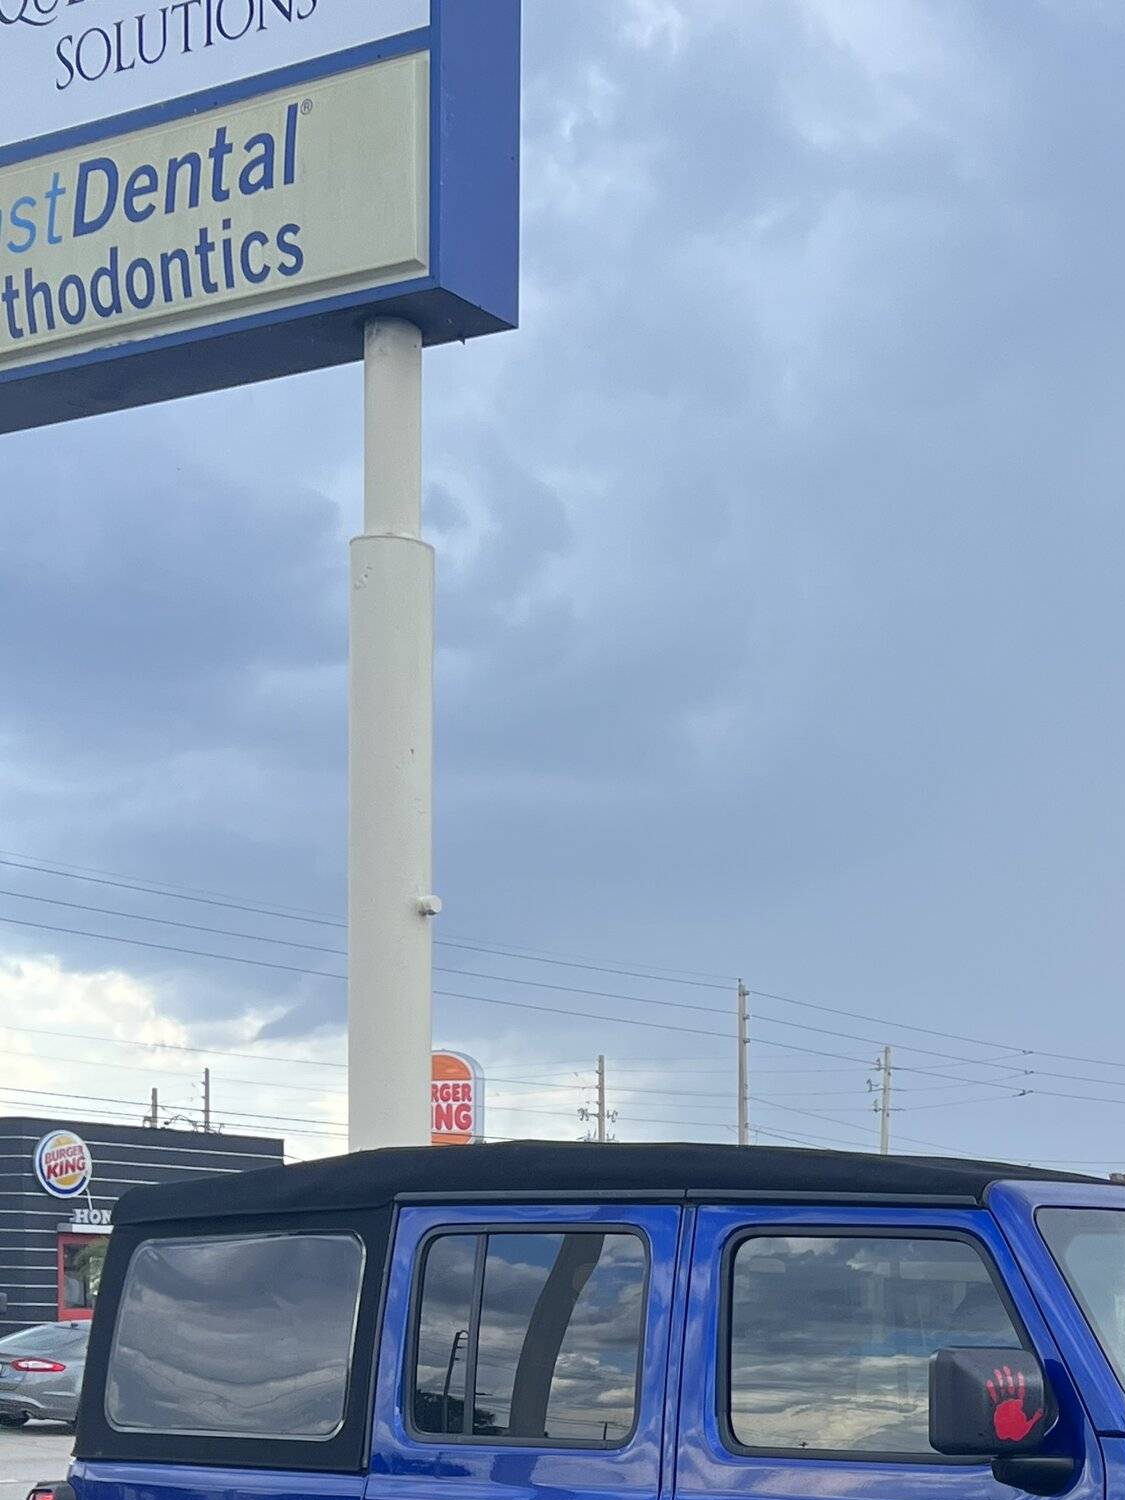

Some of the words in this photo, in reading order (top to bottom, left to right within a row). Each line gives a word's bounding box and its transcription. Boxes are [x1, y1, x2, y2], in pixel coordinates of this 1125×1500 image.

[0, 102, 299, 255] stDental
[3, 219, 304, 339] thodontics
[432, 1103, 472, 1130] NG
[45, 1145, 84, 1164] BURGER
[46, 1157, 85, 1180] KING
